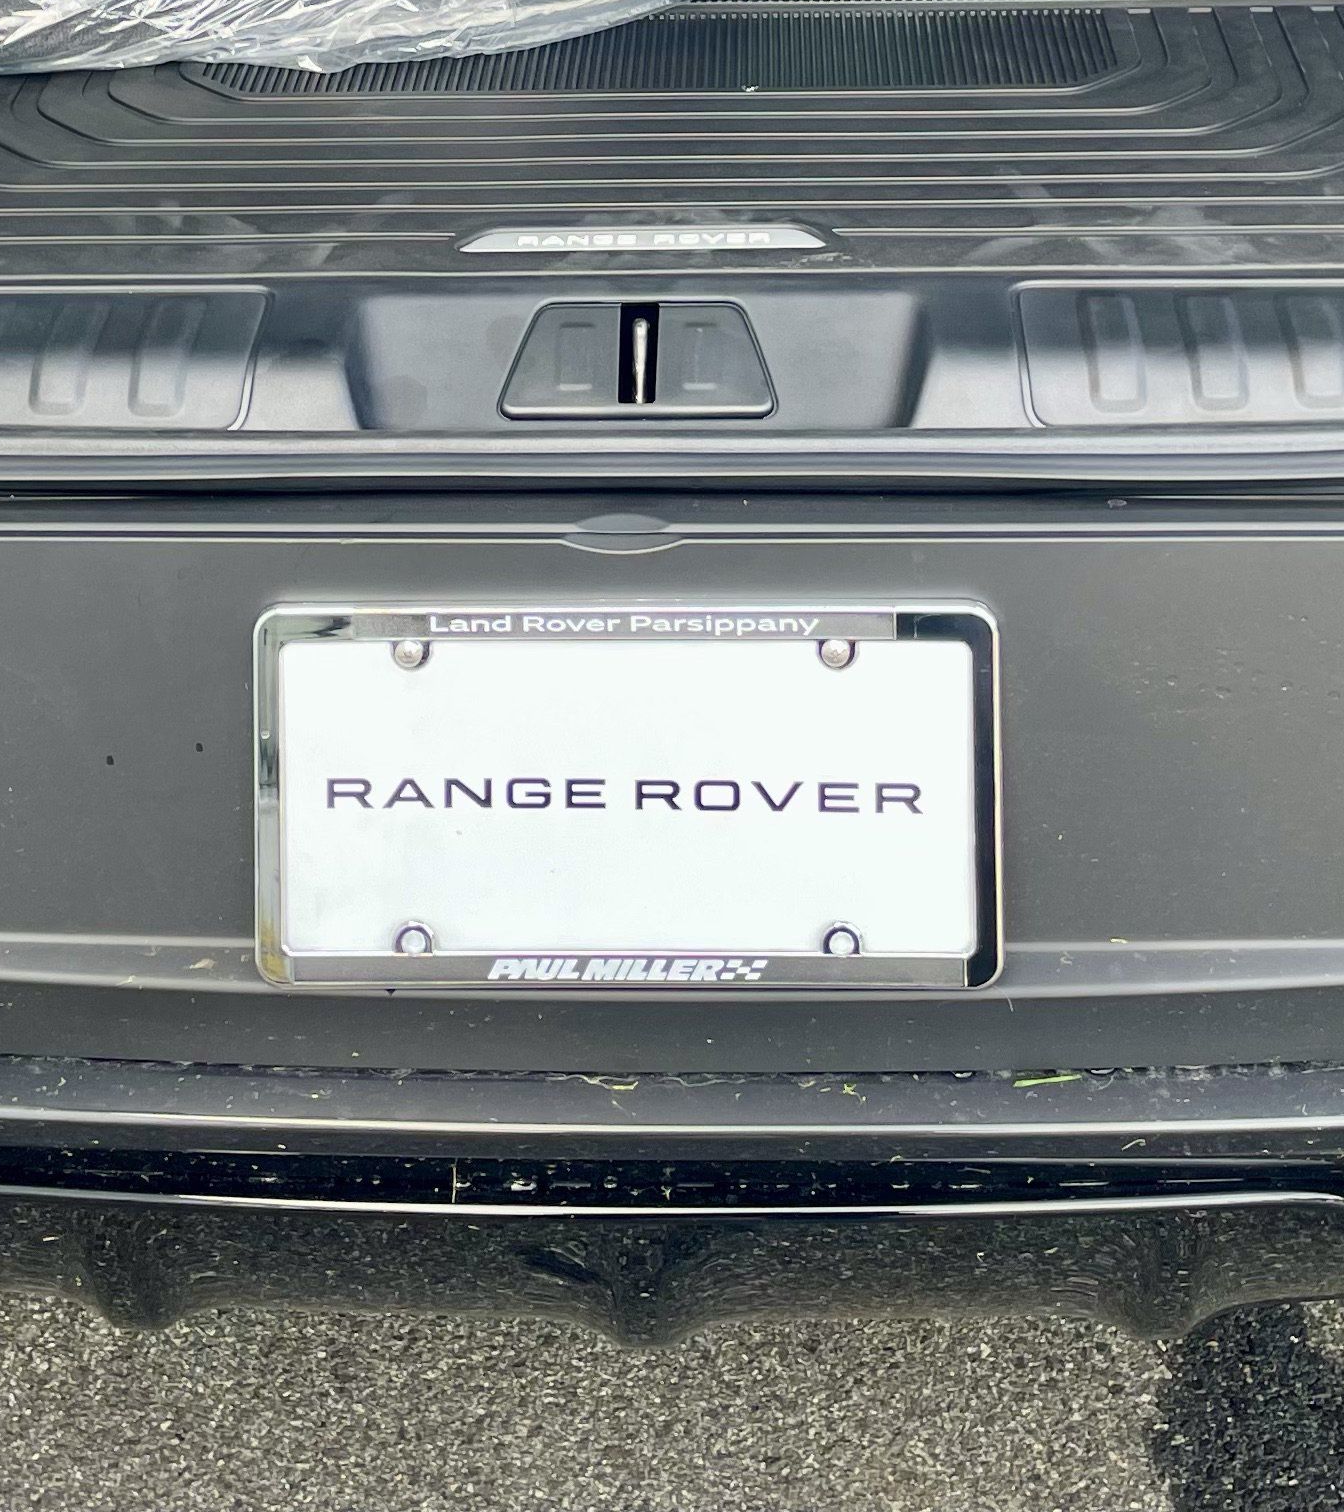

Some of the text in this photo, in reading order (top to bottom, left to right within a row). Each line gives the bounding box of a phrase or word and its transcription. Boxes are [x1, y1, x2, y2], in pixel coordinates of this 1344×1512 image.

[516, 231, 771, 248] RANGE ROVER
[429, 614, 820, 636] Land Rover Parsippany
[326, 776, 924, 815] RANGE ROVER
[486, 958, 723, 981] PAUL MILLER
